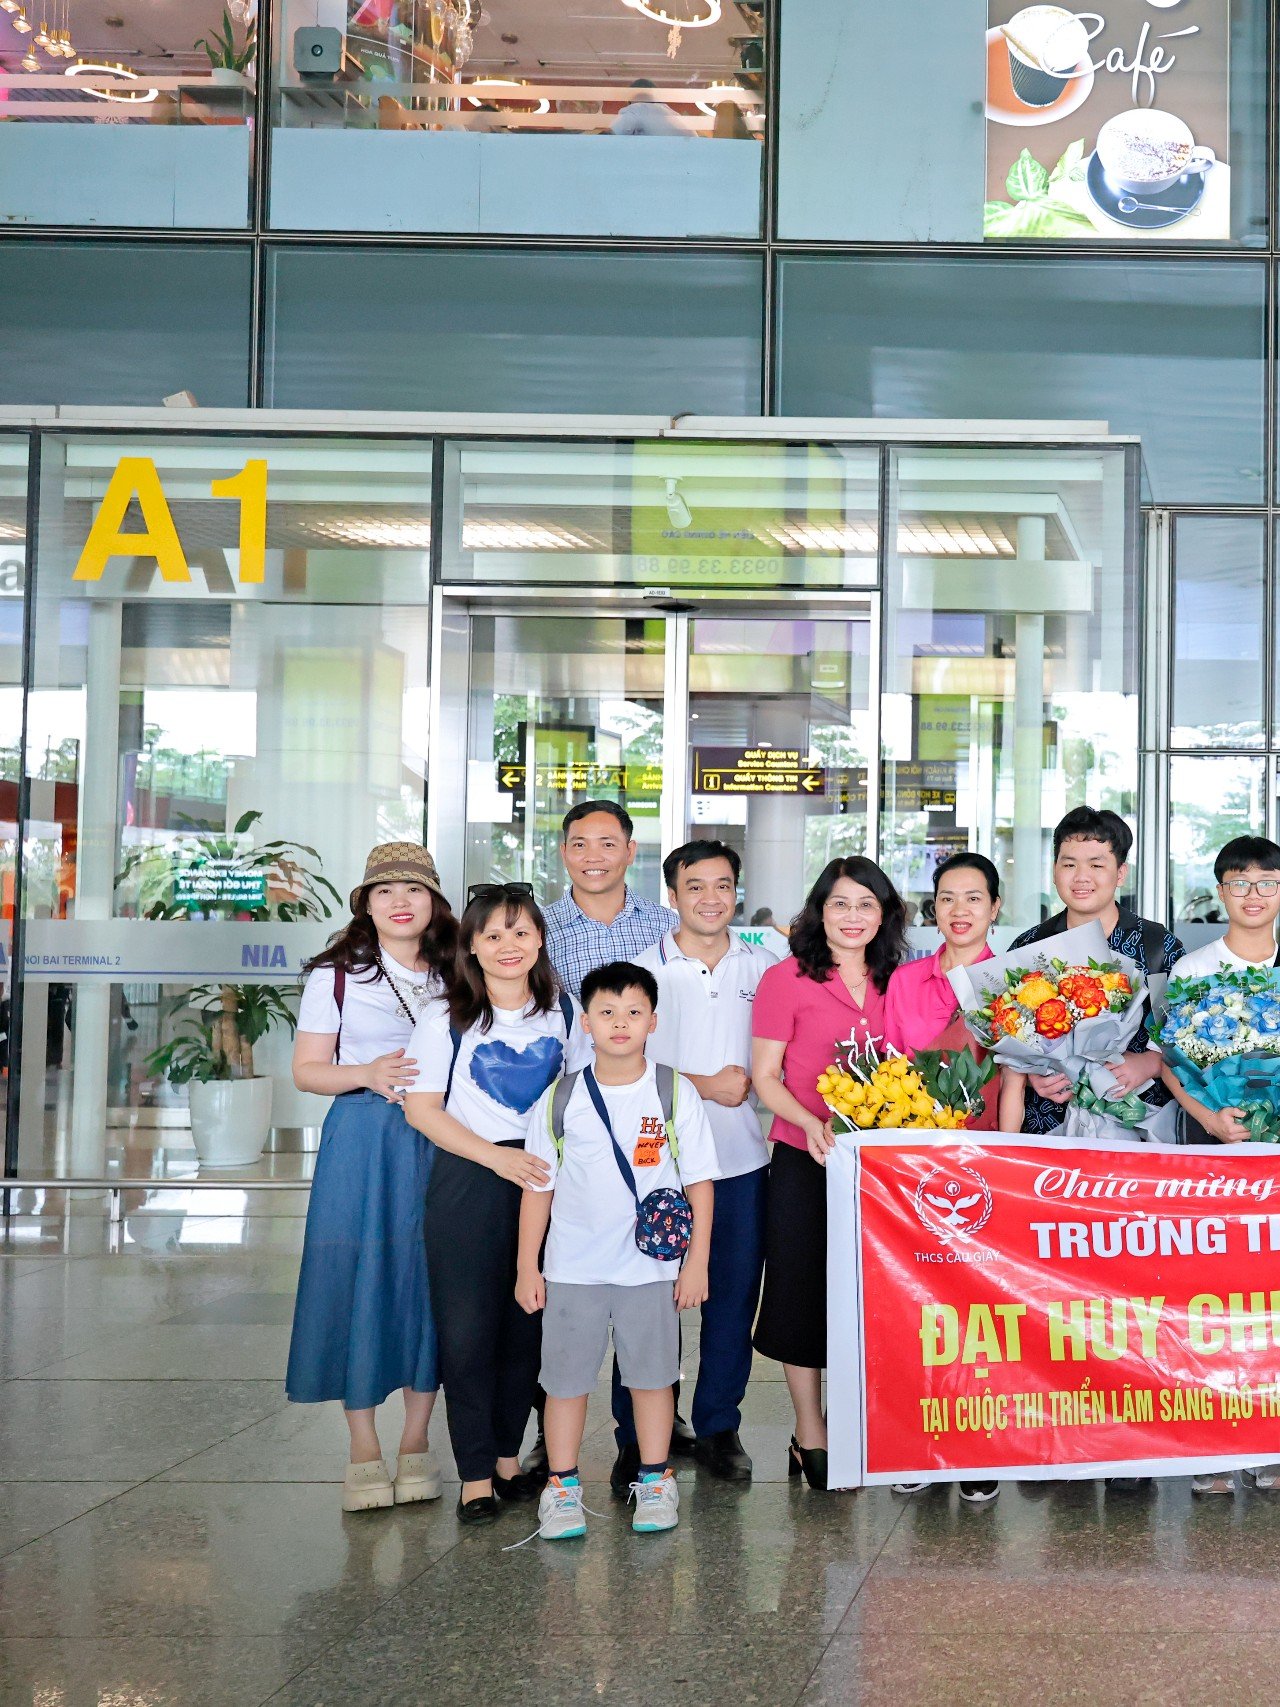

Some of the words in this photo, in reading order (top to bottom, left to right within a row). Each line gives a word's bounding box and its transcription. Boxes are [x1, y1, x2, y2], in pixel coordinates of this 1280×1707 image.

[1039, 13, 1199, 109] Café
[71, 456, 268, 584] A1
[42, 955, 60, 966] BAI
[62, 955, 112, 966] TERMINAL
[115, 955, 121, 966] 2
[241, 944, 288, 968] NIA
[1033, 1164, 1140, 1200] Chúc
[914, 1252, 944, 1263] THCS
[1030, 1211, 1228, 1259] TRƯỜNG
[919, 1302, 1027, 1380] ĐẠT
[1048, 1296, 1166, 1362] HUY
[920, 1397, 949, 1441] TẠI
[955, 1388, 1008, 1439] CUỘC
[1013, 1393, 1044, 1429] THI
[1049, 1376, 1106, 1427] TRIỂN
[1111, 1386, 1154, 1424] LÃM
[1160, 1379, 1213, 1421] SÁNG
[1217, 1385, 1254, 1427] TẠO
